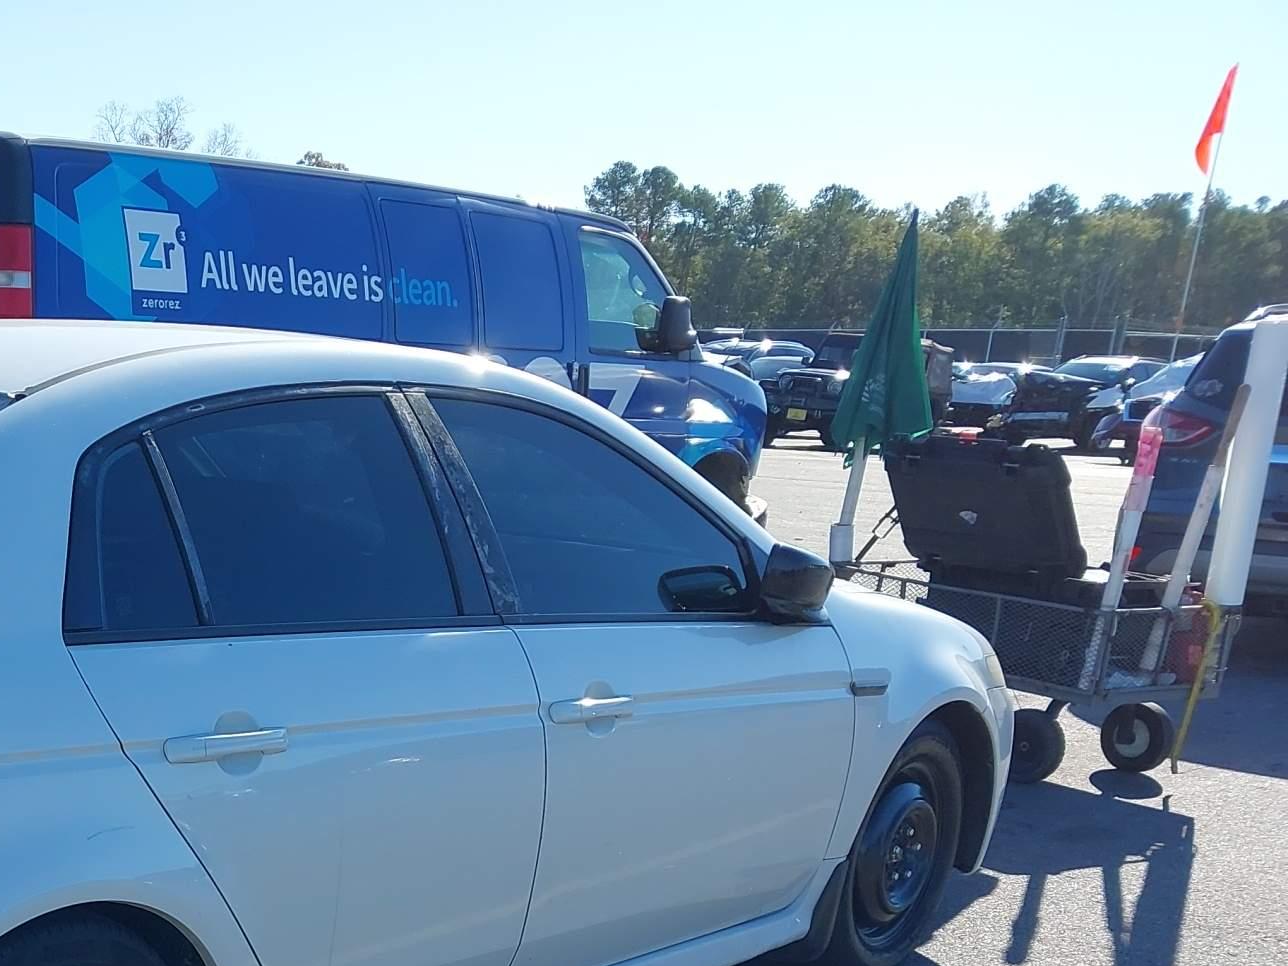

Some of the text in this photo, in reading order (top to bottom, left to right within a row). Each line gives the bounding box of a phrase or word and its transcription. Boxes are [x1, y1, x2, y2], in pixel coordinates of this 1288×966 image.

[201, 249, 458, 308] All we leave is clean.
